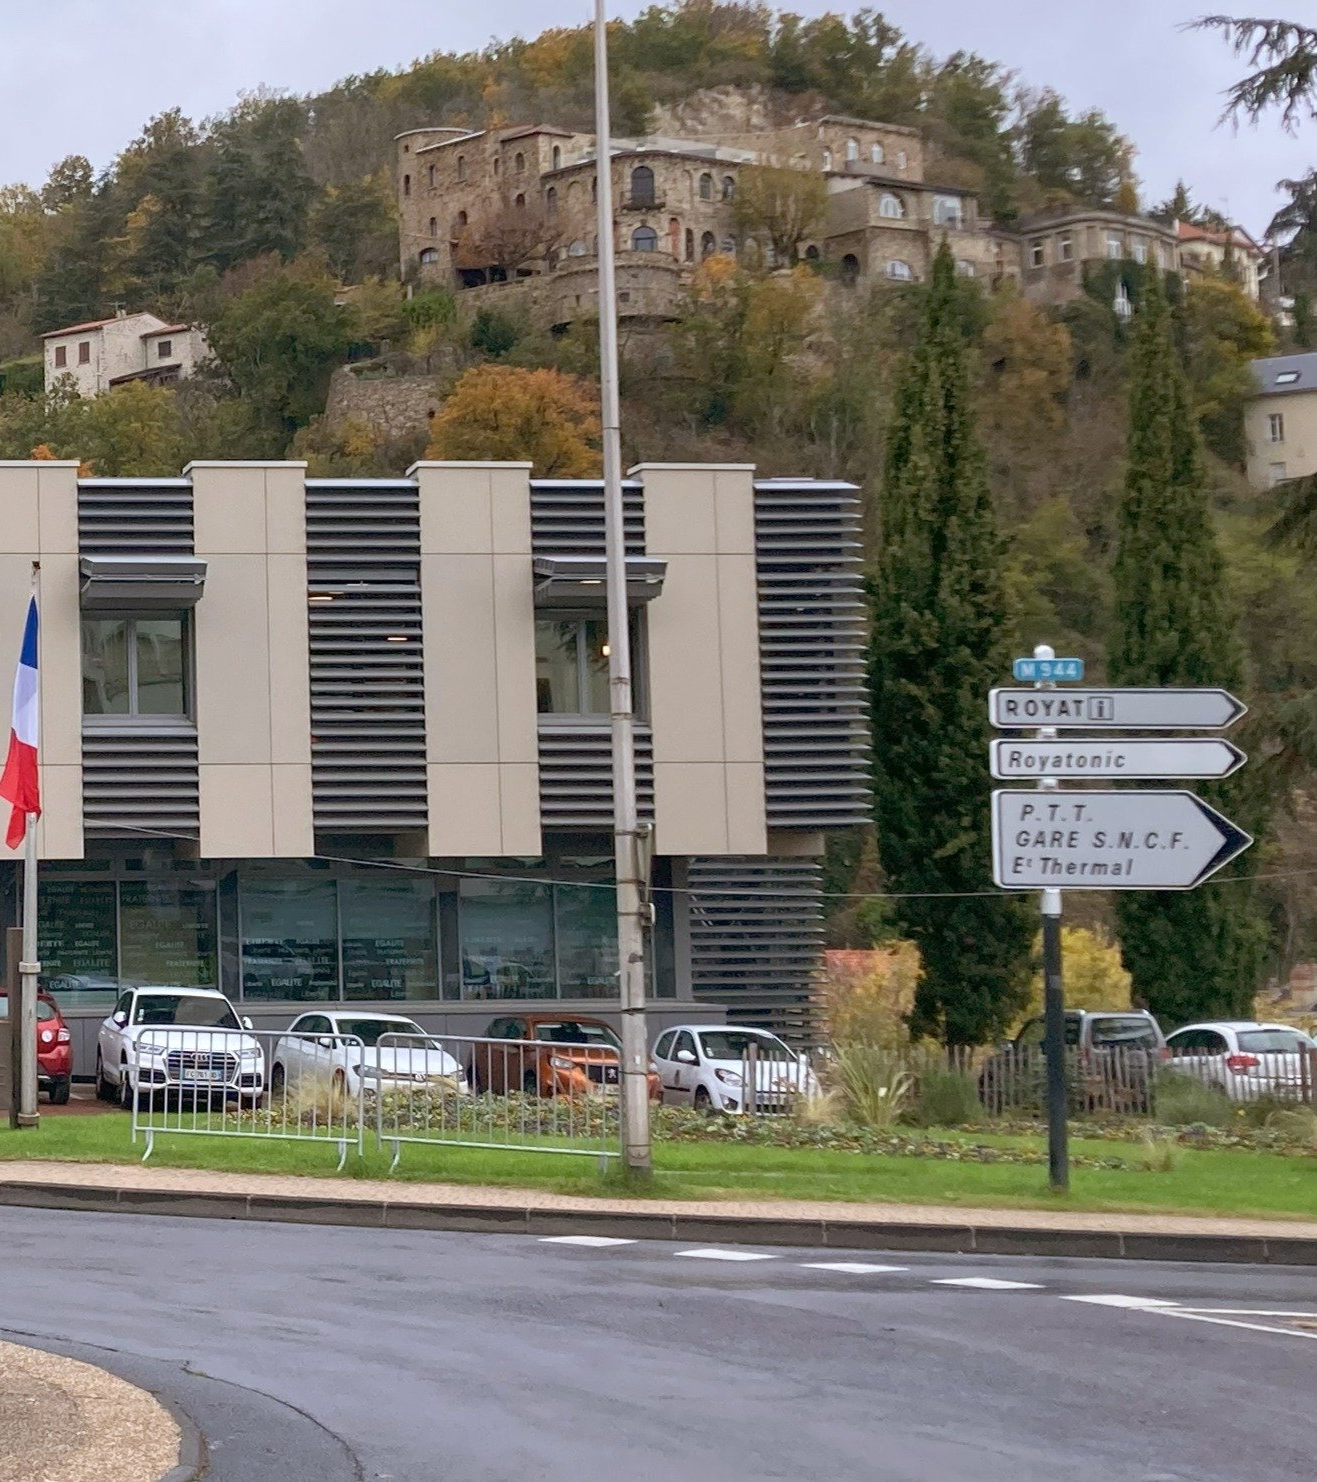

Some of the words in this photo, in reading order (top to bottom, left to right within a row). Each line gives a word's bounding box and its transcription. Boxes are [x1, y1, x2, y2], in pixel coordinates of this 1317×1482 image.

[1040, 662, 1077, 677] 944
[1006, 699, 1084, 717] ROYAT
[1009, 750, 1126, 772] Royatonic
[1020, 804, 1093, 822] P.T.T.
[1015, 831, 1080, 848] GARE
[1092, 831, 1190, 850] S.N.C.F.
[1040, 857, 1134, 876] Thermal
